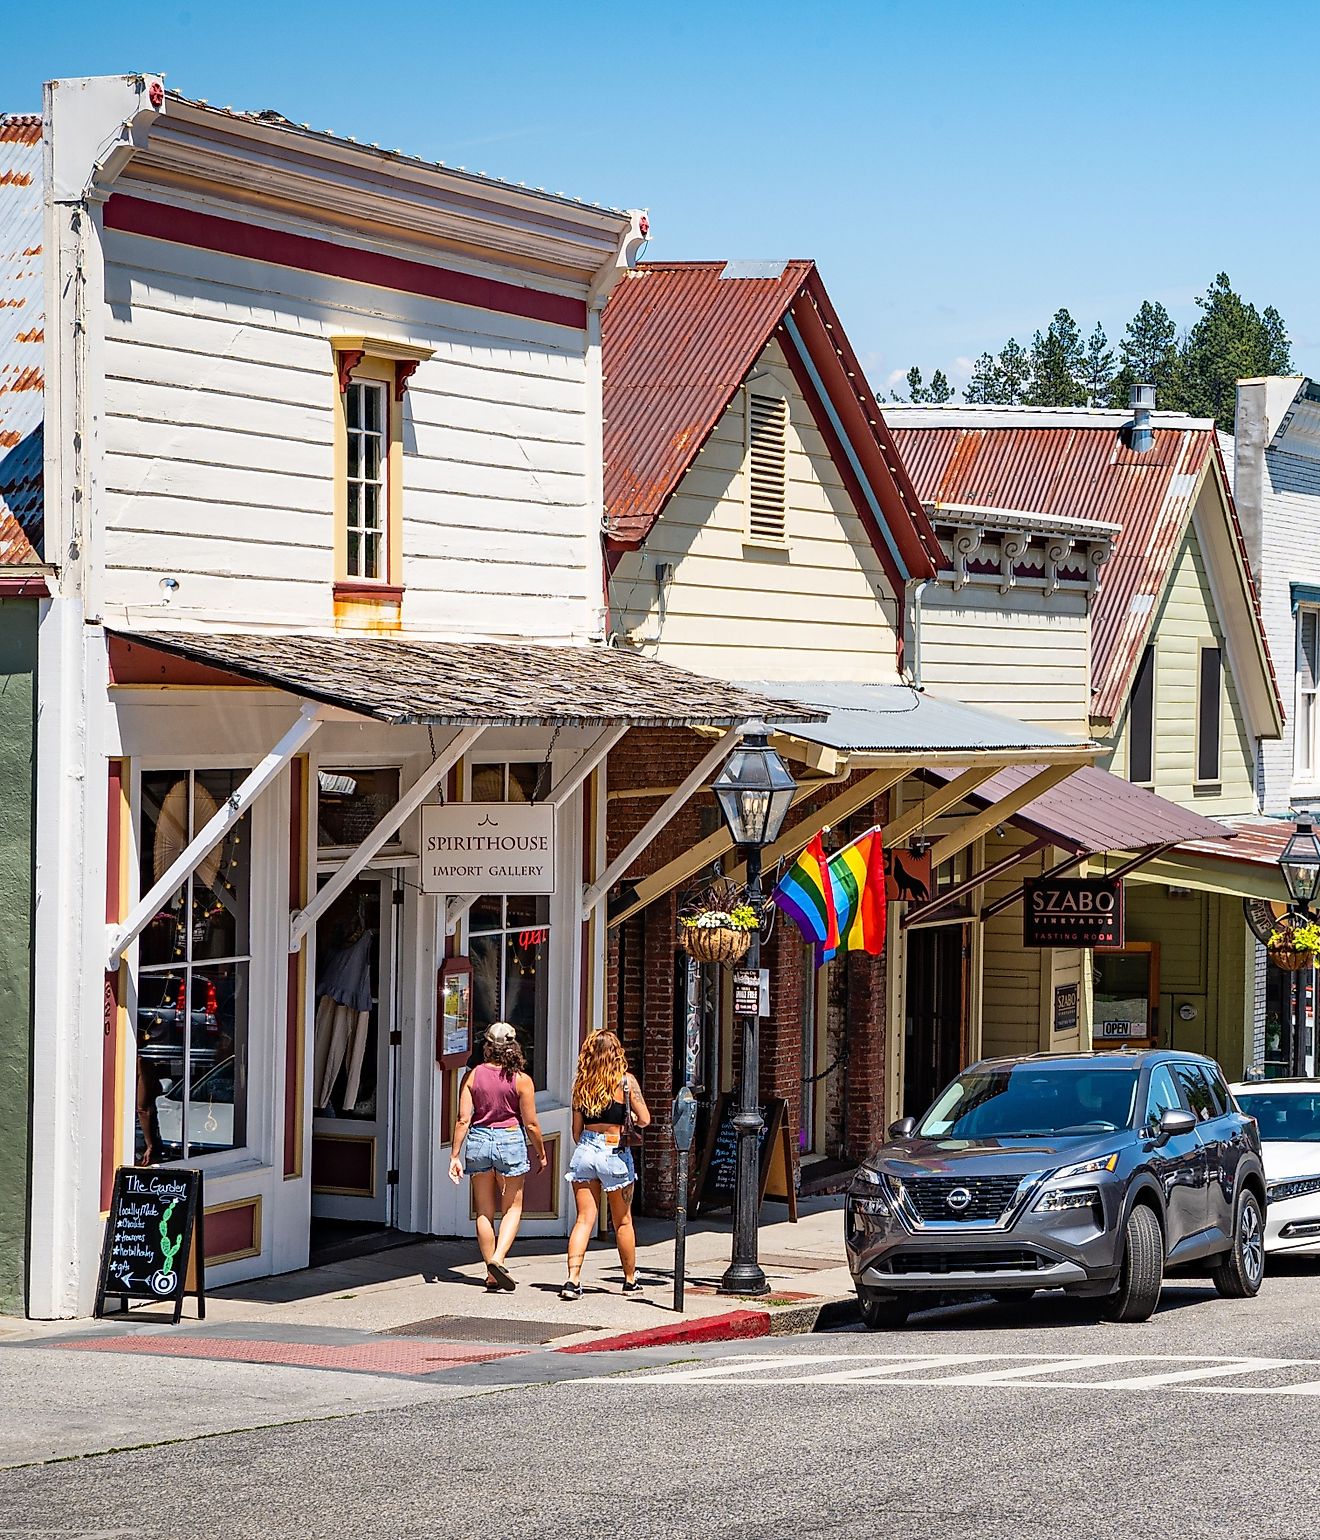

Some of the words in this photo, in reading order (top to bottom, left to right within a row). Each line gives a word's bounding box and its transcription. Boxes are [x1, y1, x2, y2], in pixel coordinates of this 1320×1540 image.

[427, 835, 549, 852] SPIRITHOUSE
[432, 866, 484, 876] IMPORT
[488, 866, 544, 877] GALLERY
[1032, 890, 1114, 912] SZABO
[1034, 917, 1113, 925] VINEYARDS
[1057, 993, 1076, 1008] SZABO
[1105, 1022, 1129, 1035] OPEN
[125, 1174, 148, 1192] The
[149, 1177, 187, 1198] Garden
